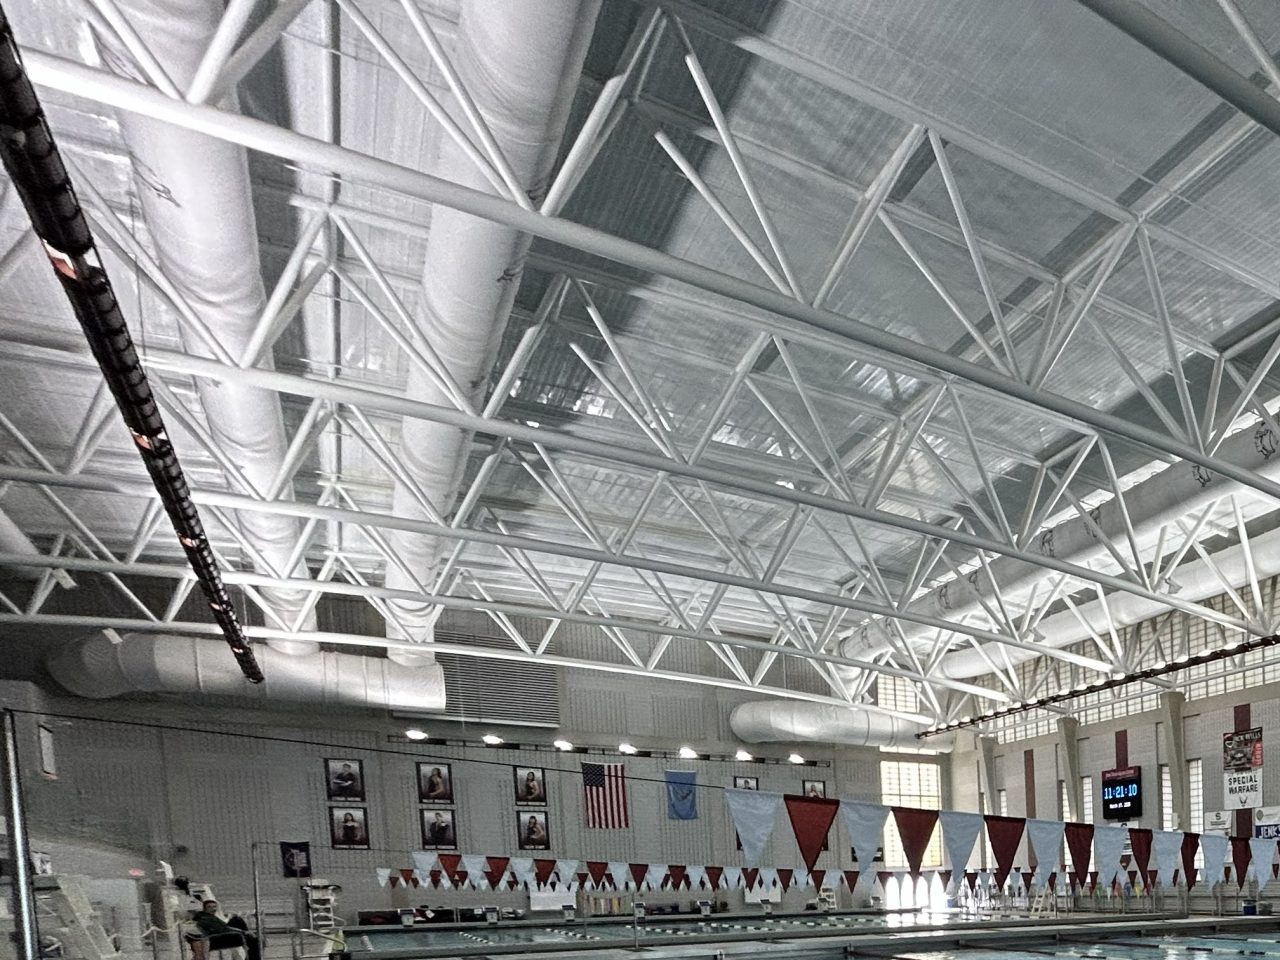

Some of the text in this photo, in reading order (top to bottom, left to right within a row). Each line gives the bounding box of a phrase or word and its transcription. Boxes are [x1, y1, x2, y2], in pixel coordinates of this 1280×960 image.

[1228, 775, 1258, 786] SPECIAL
[1104, 783, 1137, 800] 11:21:10
[1228, 784, 1258, 795] WARFARE
